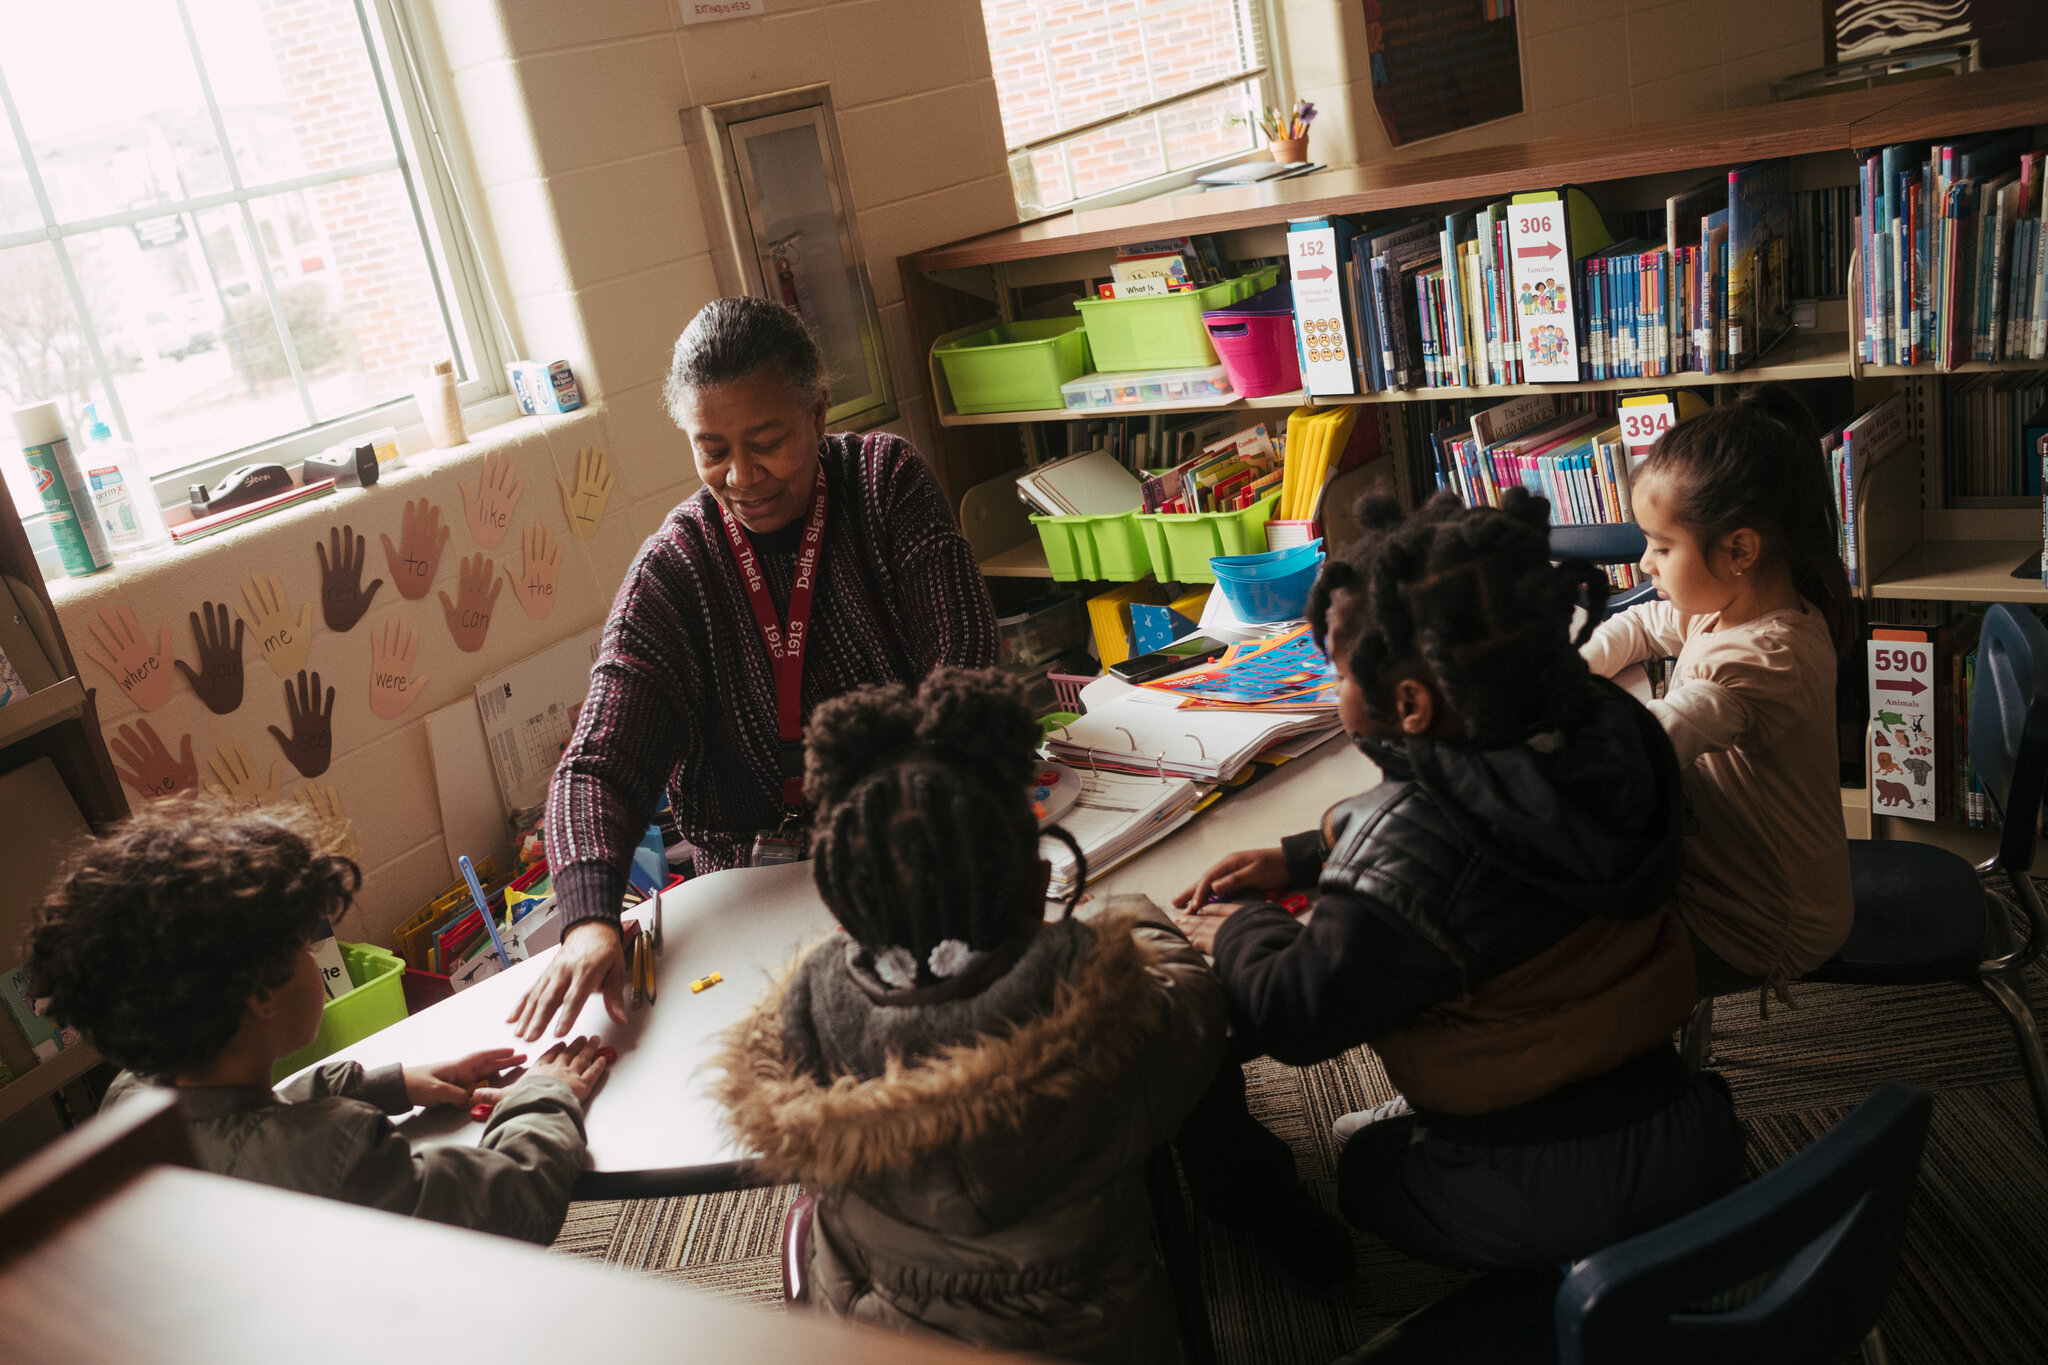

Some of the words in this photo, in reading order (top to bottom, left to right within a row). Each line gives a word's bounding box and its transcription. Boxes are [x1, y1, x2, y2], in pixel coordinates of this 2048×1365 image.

[1520, 216, 1552, 234] 306
[1299, 241, 1325, 257] 152
[1527, 266, 1555, 274] Families
[1126, 285, 1145, 294] What
[1503, 408, 1515, 419] The
[1516, 401, 1532, 415] Story
[1495, 422, 1517, 440] RUBY
[1518, 406, 1554, 431] BRIDGES
[1626, 413, 1670, 438] 394
[479, 499, 507, 529] like
[576, 491, 599, 523] I
[723, 508, 742, 546] igma
[739, 547, 761, 593] Theta
[797, 549, 815, 590] Delta
[807, 495, 825, 543] Sigma
[403, 551, 429, 577] to
[527, 577, 554, 598] the
[461, 609, 489, 629] can
[264, 629, 293, 653] me
[764, 624, 784, 659] 1913
[787, 620, 804, 657] 1913
[1875, 649, 1927, 673] 590
[121, 655, 160, 692] where
[207, 662, 239, 691] you
[375, 672, 408, 692] were
[503, 682, 512, 699] 3M
[1885, 698, 1920, 708] Animals
